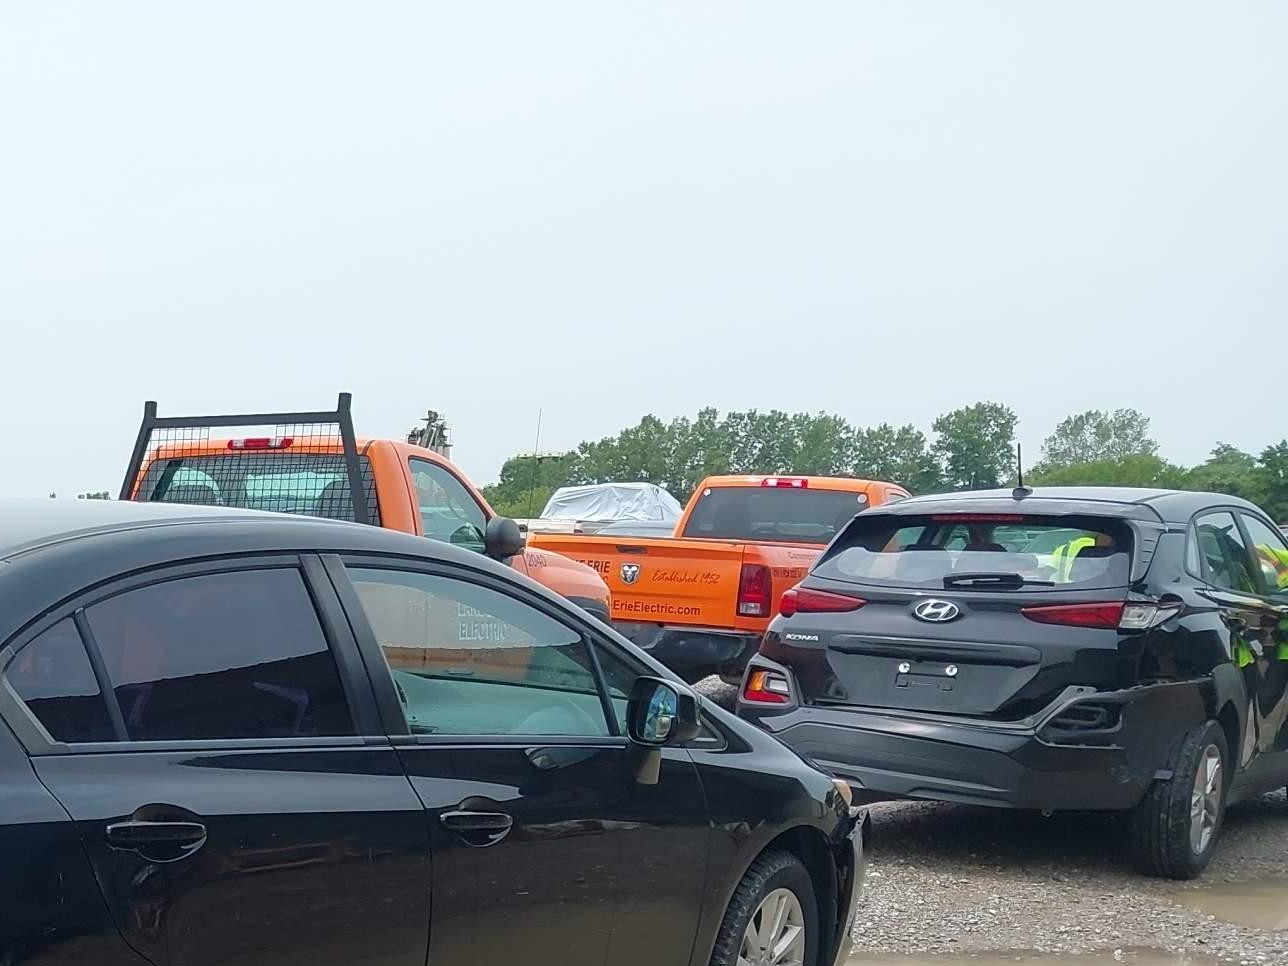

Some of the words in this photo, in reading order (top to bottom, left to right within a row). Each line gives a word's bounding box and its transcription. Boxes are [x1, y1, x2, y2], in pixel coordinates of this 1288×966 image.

[652, 569, 698, 584] Established
[700, 572, 721, 585] 1952
[786, 633, 819, 642] KONA
